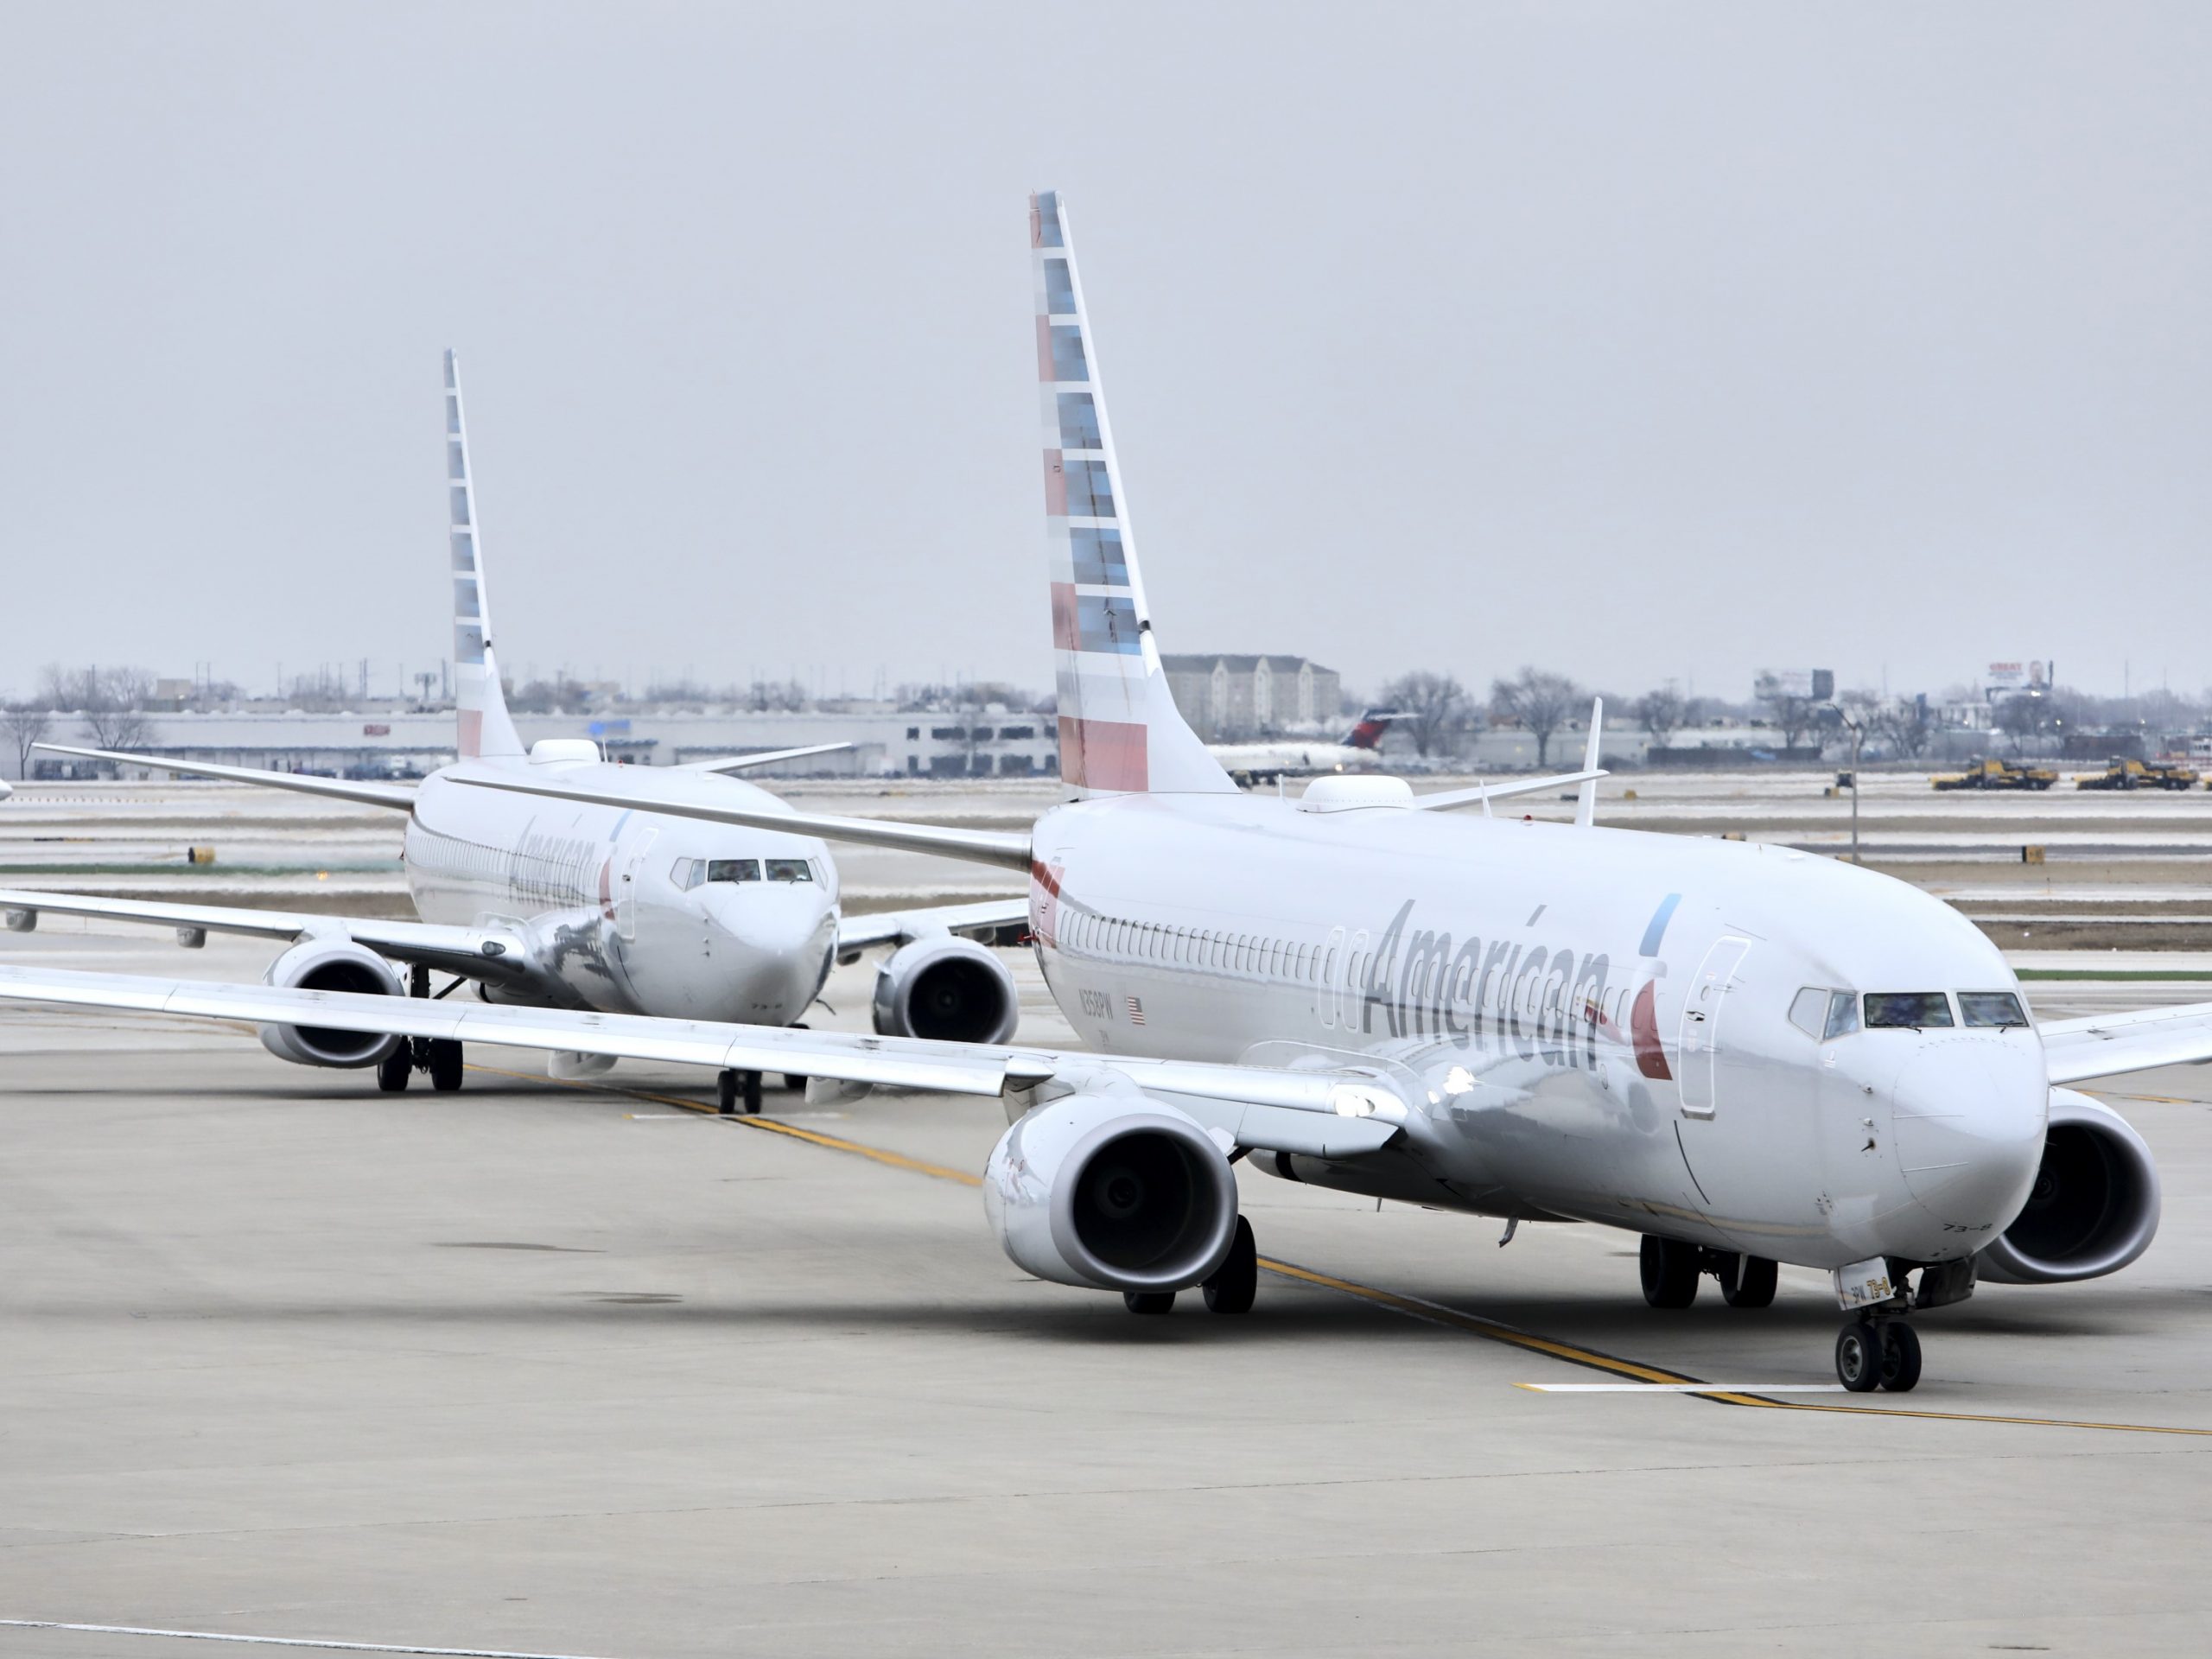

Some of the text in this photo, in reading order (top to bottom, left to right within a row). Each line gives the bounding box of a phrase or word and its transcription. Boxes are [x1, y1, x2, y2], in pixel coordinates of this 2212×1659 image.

[1363, 899, 1610, 1071] American
[1942, 1223, 1993, 1233] 73-8
[1866, 1276, 1891, 1300] 73-8
